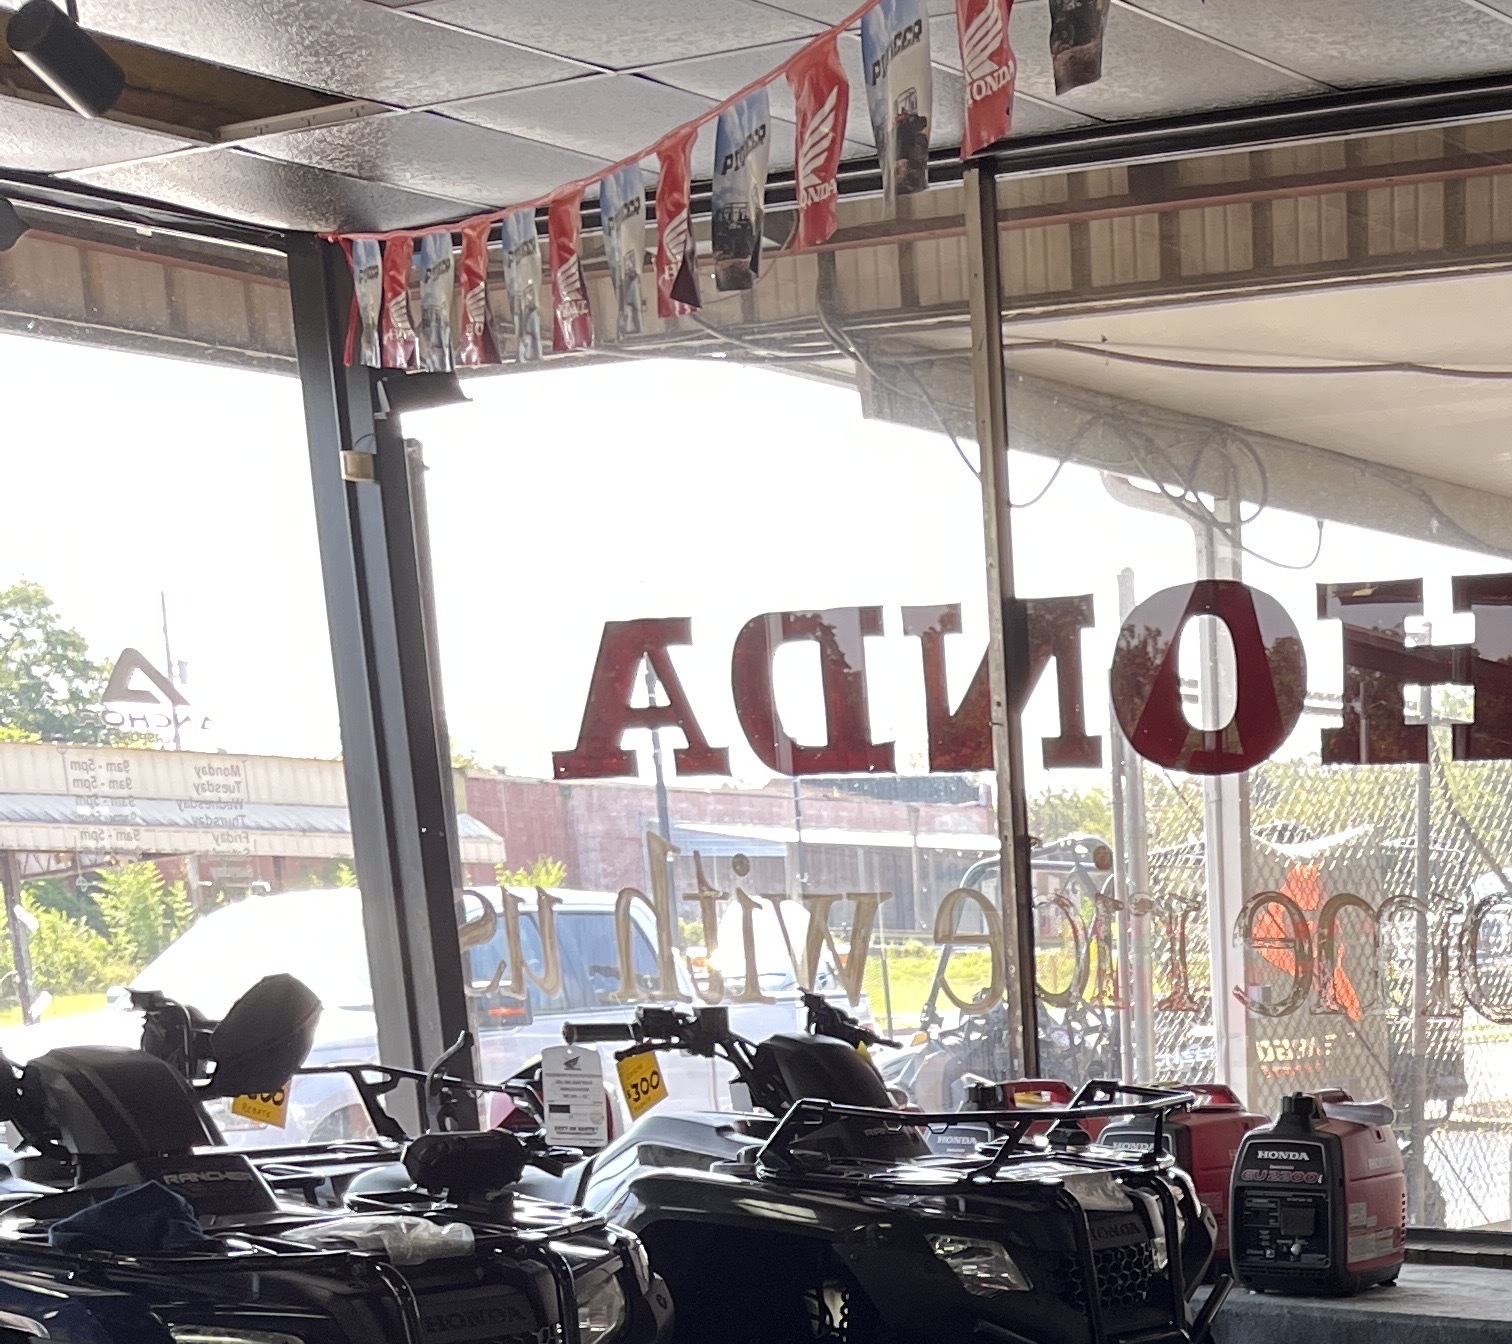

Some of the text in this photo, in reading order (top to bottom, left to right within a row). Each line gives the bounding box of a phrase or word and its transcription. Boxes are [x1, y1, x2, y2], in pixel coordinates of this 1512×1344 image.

[800, 178, 838, 209] ONDA
[1256, 1150, 1311, 1162] HONDA
[423, 1306, 524, 1333] HONDA
